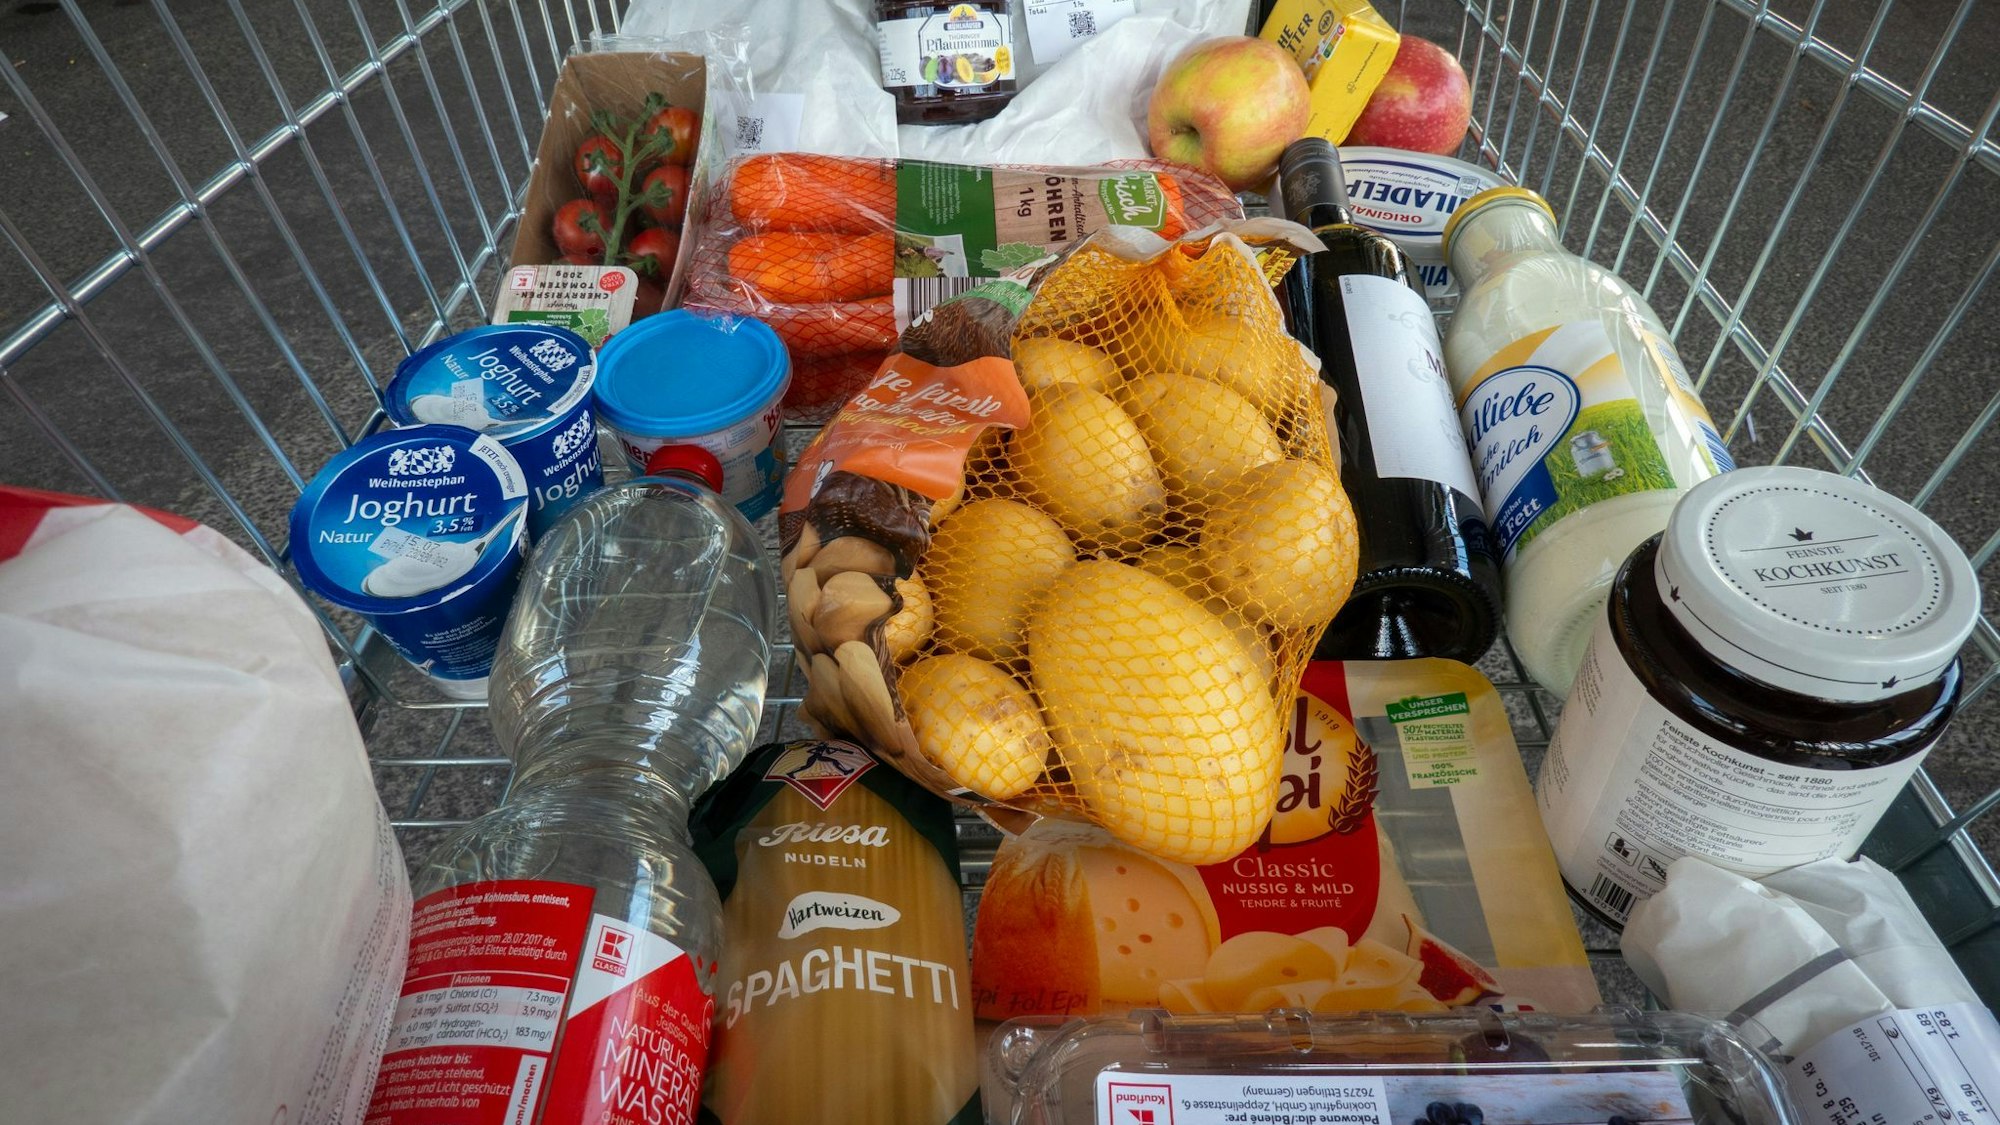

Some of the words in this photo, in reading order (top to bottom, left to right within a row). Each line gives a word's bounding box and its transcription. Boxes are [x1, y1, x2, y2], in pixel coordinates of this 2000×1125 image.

[1029, 7, 1047, 15] Total
[1277, 24, 1295, 49] HE
[1287, 12, 1314, 54] TTER
[927, 38, 999, 51] Pflaumenmus
[1143, 174, 1158, 206] MARKT-
[1346, 179, 1468, 214] ILADELP
[1017, 199, 1032, 218] kg
[1045, 176, 1067, 242] ÖHREN
[556, 270, 583, 279] 200g
[1417, 265, 1448, 286] HIA
[539, 281, 594, 289] TOMATEN
[516, 291, 609, 300] CHERRYRISPEN-
[441, 353, 471, 380] Natur
[508, 344, 555, 386] Weihenstephan
[467, 347, 543, 406] Joghurt
[477, 444, 500, 461] JETZT
[368, 475, 466, 489] Weihenstephan
[343, 491, 478, 527] Joghurt
[432, 518, 460, 534] 3,5
[462, 516, 475, 526] %
[1505, 497, 1541, 541] Fett
[318, 530, 374, 544] Natur
[1786, 545, 1844, 559] FEINSTE
[1753, 553, 1902, 582] KOCHKUNST
[1390, 702, 1467, 720] VERSPRECHEN
[1408, 698, 1444, 709] UNSER
[1403, 725, 1423, 734] 50%
[1652, 740, 1692, 772] Langbein
[1660, 727, 1731, 770] Anspruchsvoller
[1662, 720, 1700, 748] Feinste
[1702, 745, 1765, 774] Kochkunst
[1777, 773, 1800, 782] seit
[1804, 776, 1833, 785] 1880
[1412, 768, 1478, 779] FRANZÖSISCHE
[1431, 762, 1454, 770] 100%
[1656, 734, 1667, 745] für
[1668, 742, 1682, 755] die
[1684, 750, 1721, 775] kreative
[1721, 770, 1755, 788] Küche
[1788, 790, 1810, 799] sind
[1677, 771, 1720, 798] enthalten
[1637, 789, 1664, 810] davon
[1653, 808, 1684, 829] acides
[1684, 824, 1706, 838] gras
[1690, 813, 1728, 832] grasses
[758, 821, 890, 848] Riesa
[784, 852, 866, 868] NUDELN
[1710, 849, 1744, 864] sucres
[1233, 857, 1336, 879] Classic
[1222, 883, 1289, 895] NUSSIG
[1295, 883, 1306, 895] &
[1312, 883, 1354, 895] MILD
[483, 891, 530, 903] Kohlensäure,
[532, 893, 570, 907] enteisent,
[1240, 899, 1287, 908] TENDRE
[1290, 899, 1298, 908] &
[1300, 896, 1342, 908] FRUITÉ
[789, 901, 885, 930] Hartweizen
[543, 937, 556, 947] der
[508, 944, 543, 960] bestätigt
[544, 947, 568, 961] durch
[594, 961, 625, 976] CLASSIC
[454, 974, 491, 984] Anionen
[726, 945, 959, 1030] SPAGHETTI
[450, 988, 479, 999] Chlorid
[527, 991, 540, 1002] 7,3
[540, 993, 562, 1005] mg/l
[634, 988, 660, 1008] Aus
[661, 1000, 679, 1019] der
[423, 1004, 443, 1016] mg/l
[444, 1003, 471, 1014] Sulfat
[521, 1005, 536, 1017] 3,9
[536, 1007, 558, 1019] mg/l
[406, 1021, 418, 1033] 6,0
[418, 1019, 438, 1031] mg/l
[439, 1017, 485, 1029] Hydrogen-
[656, 1015, 689, 1046] Jessen
[1886, 1027, 1899, 1039] €
[1916, 1013, 1938, 1036] 1.83
[1934, 1010, 1960, 1039] 1.83
[436, 1028, 475, 1040] carbonat
[514, 1026, 530, 1037] 183
[530, 1029, 553, 1041] mg/l
[1852, 1027, 1881, 1062] 10:17:18
[417, 1054, 453, 1066] haltbar
[454, 1053, 473, 1064] bis:
[610, 1016, 700, 1091] NATÜRLICHES
[409, 1068, 445, 1081] Flasche
[445, 1067, 485, 1080] stehend,
[1801, 1062, 1815, 1075] KG
[417, 1082, 435, 1093] und
[436, 1081, 460, 1093] Licht
[462, 1082, 512, 1096] geschützt
[602, 1038, 695, 1123] MINERAL
[1816, 1079, 1830, 1098] Co.
[1116, 1093, 1166, 1105] Kaufland
[1242, 1085, 1294, 1098] (Germany)
[1296, 1086, 1341, 1098] Ettlingen
[1343, 1087, 1374, 1097] 76275
[1960, 1083, 1987, 1113] 13.90
[415, 1097, 461, 1109] innerhalb
[462, 1097, 481, 1108] von
[1181, 1099, 1192, 1110] 6,
[1193, 1099, 1270, 1112] Zeppelinstrasse
[1271, 1100, 1308, 1112] GmbH,
[1309, 1100, 1377, 1112] Looking4fruit
[1838, 1097, 1860, 1119] 139
[1224, 1112, 1248, 1122] pre:
